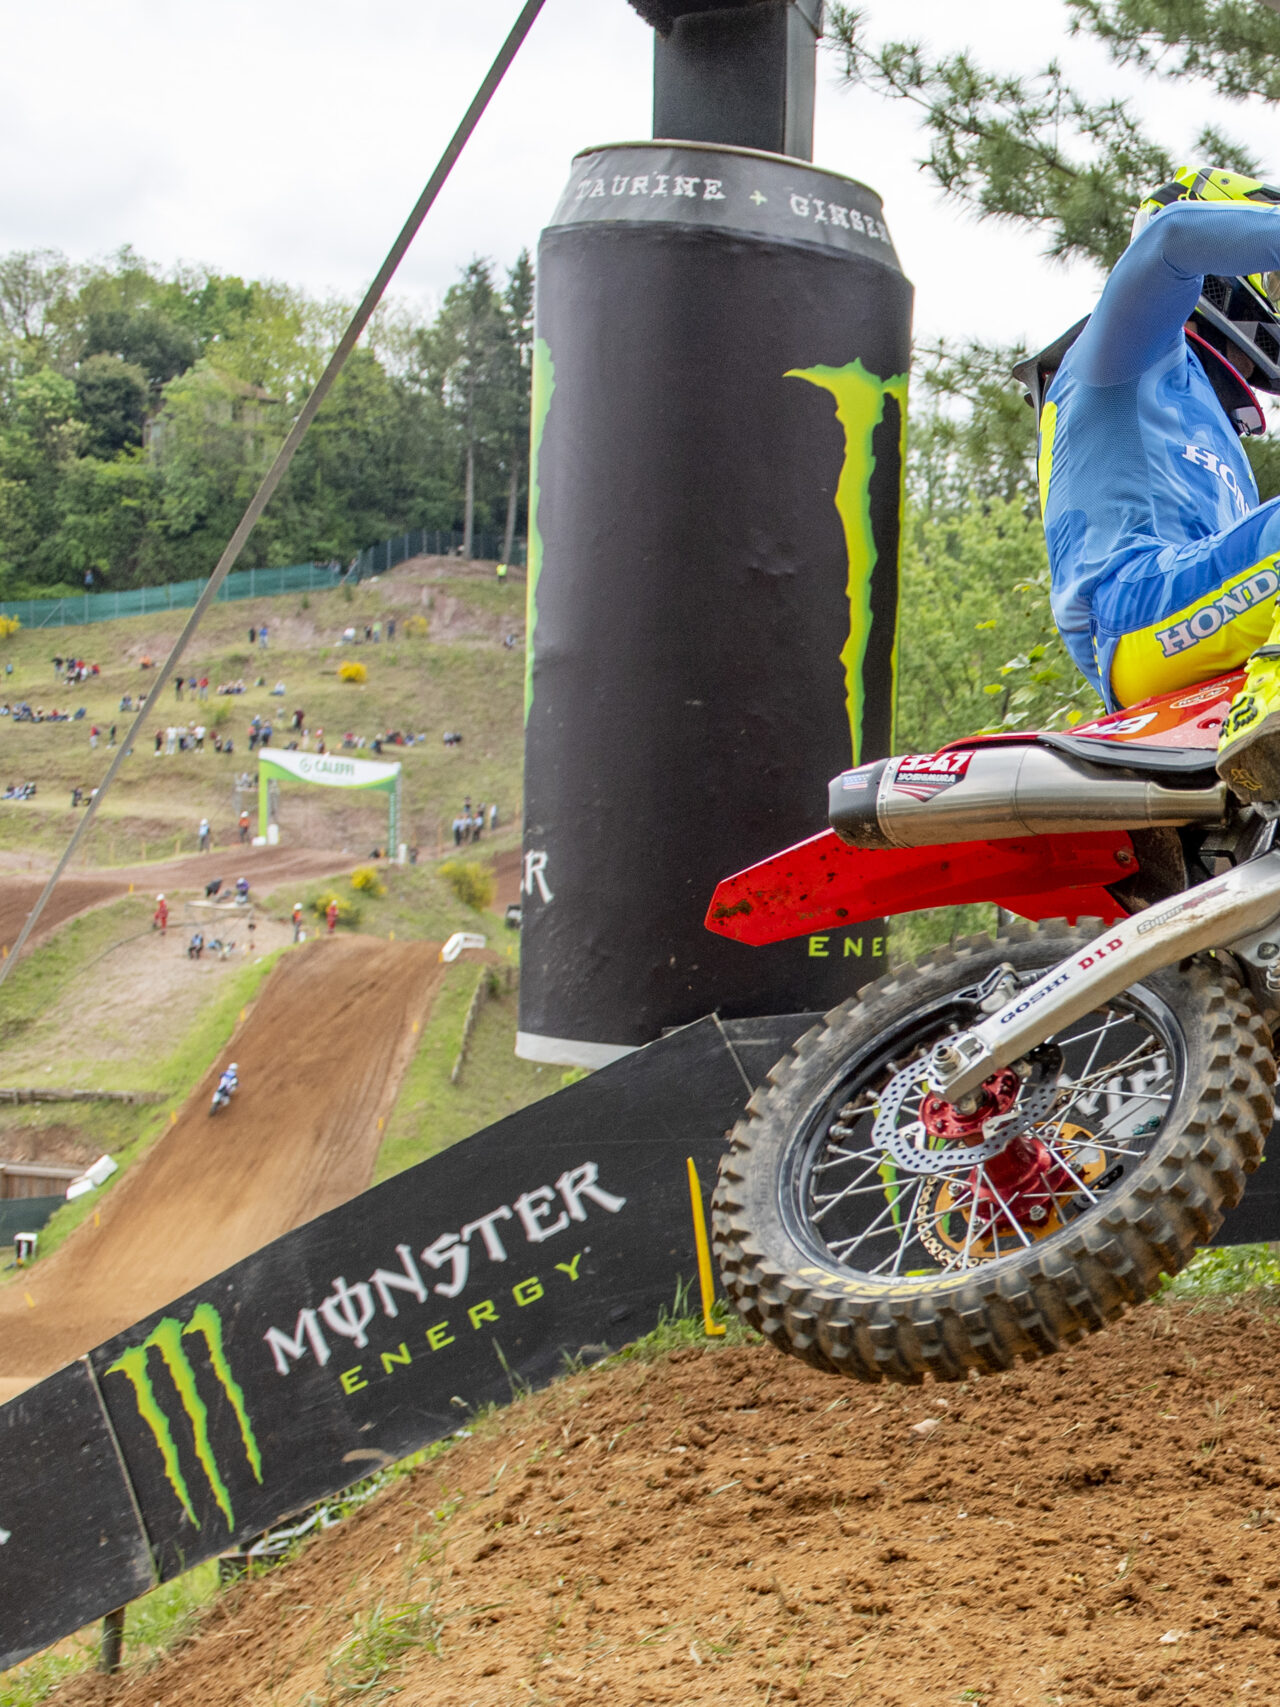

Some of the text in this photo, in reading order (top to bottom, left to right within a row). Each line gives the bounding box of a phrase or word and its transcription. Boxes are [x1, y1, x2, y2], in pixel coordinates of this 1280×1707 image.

[575, 173, 727, 201] TAURINE
[1181, 444, 1252, 517] HON
[315, 760, 355, 776] CALEFFI
[808, 936, 884, 957] ENE
[1000, 972, 1071, 1025] GOSHI
[263, 1160, 627, 1376] MONSTER
[339, 1253, 582, 1396] ENERGY
